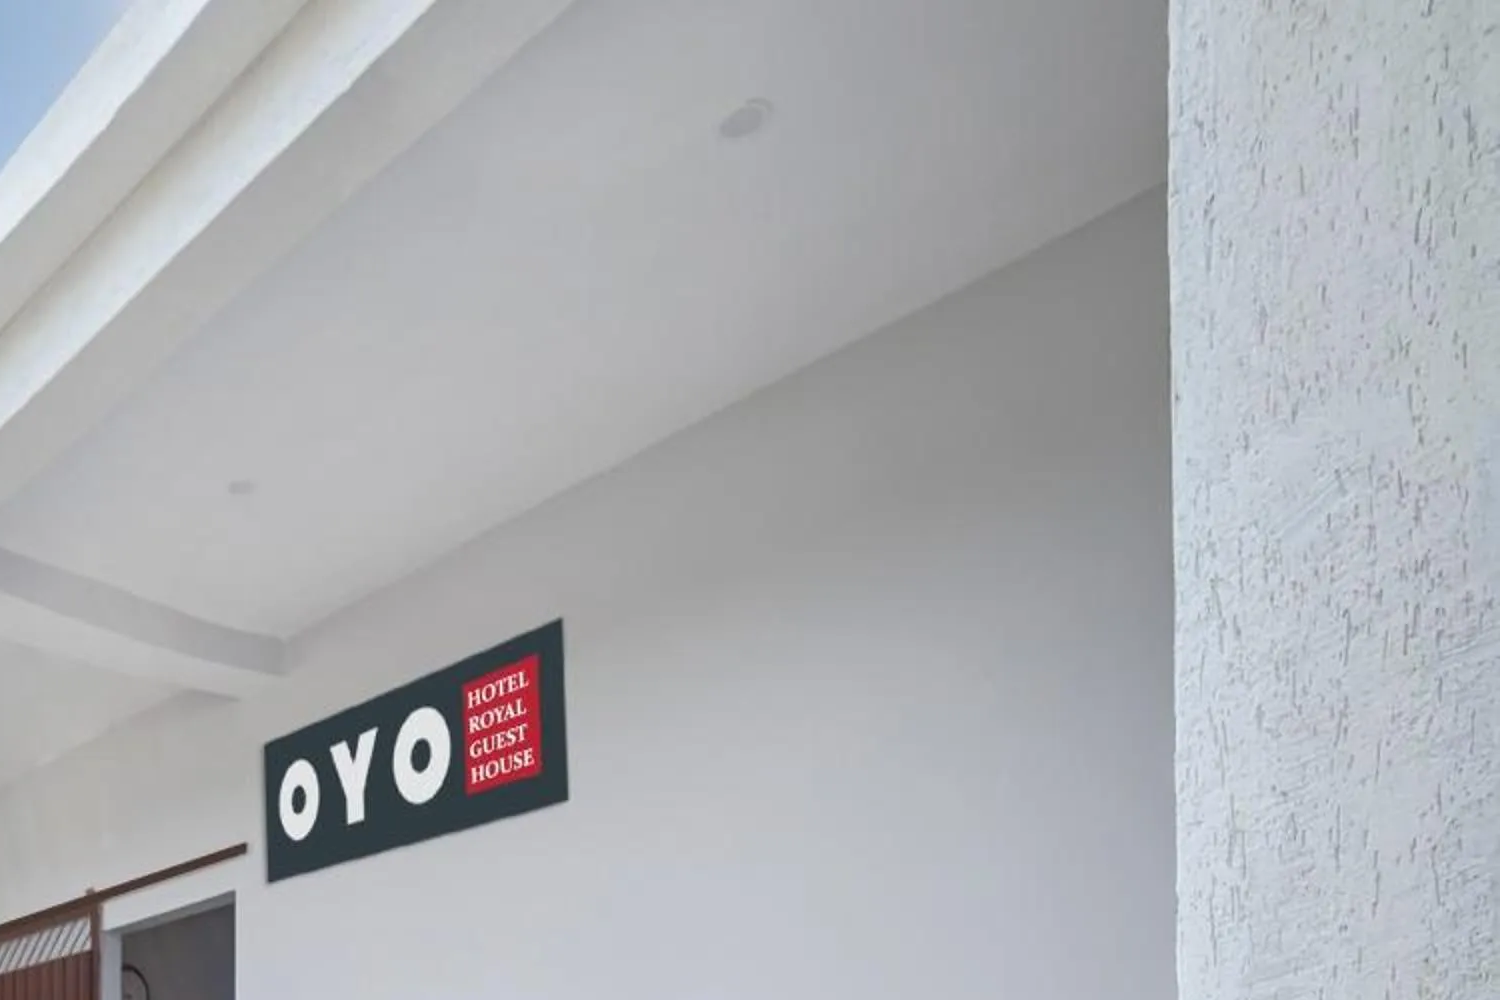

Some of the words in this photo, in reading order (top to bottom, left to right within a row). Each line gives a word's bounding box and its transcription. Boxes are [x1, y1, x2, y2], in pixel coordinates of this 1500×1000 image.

[467, 671, 529, 709] HOTEL
[468, 698, 527, 734] ROYAL
[469, 723, 528, 759] GUEST
[278, 706, 451, 841] OYO
[470, 748, 535, 784] HOUSE
